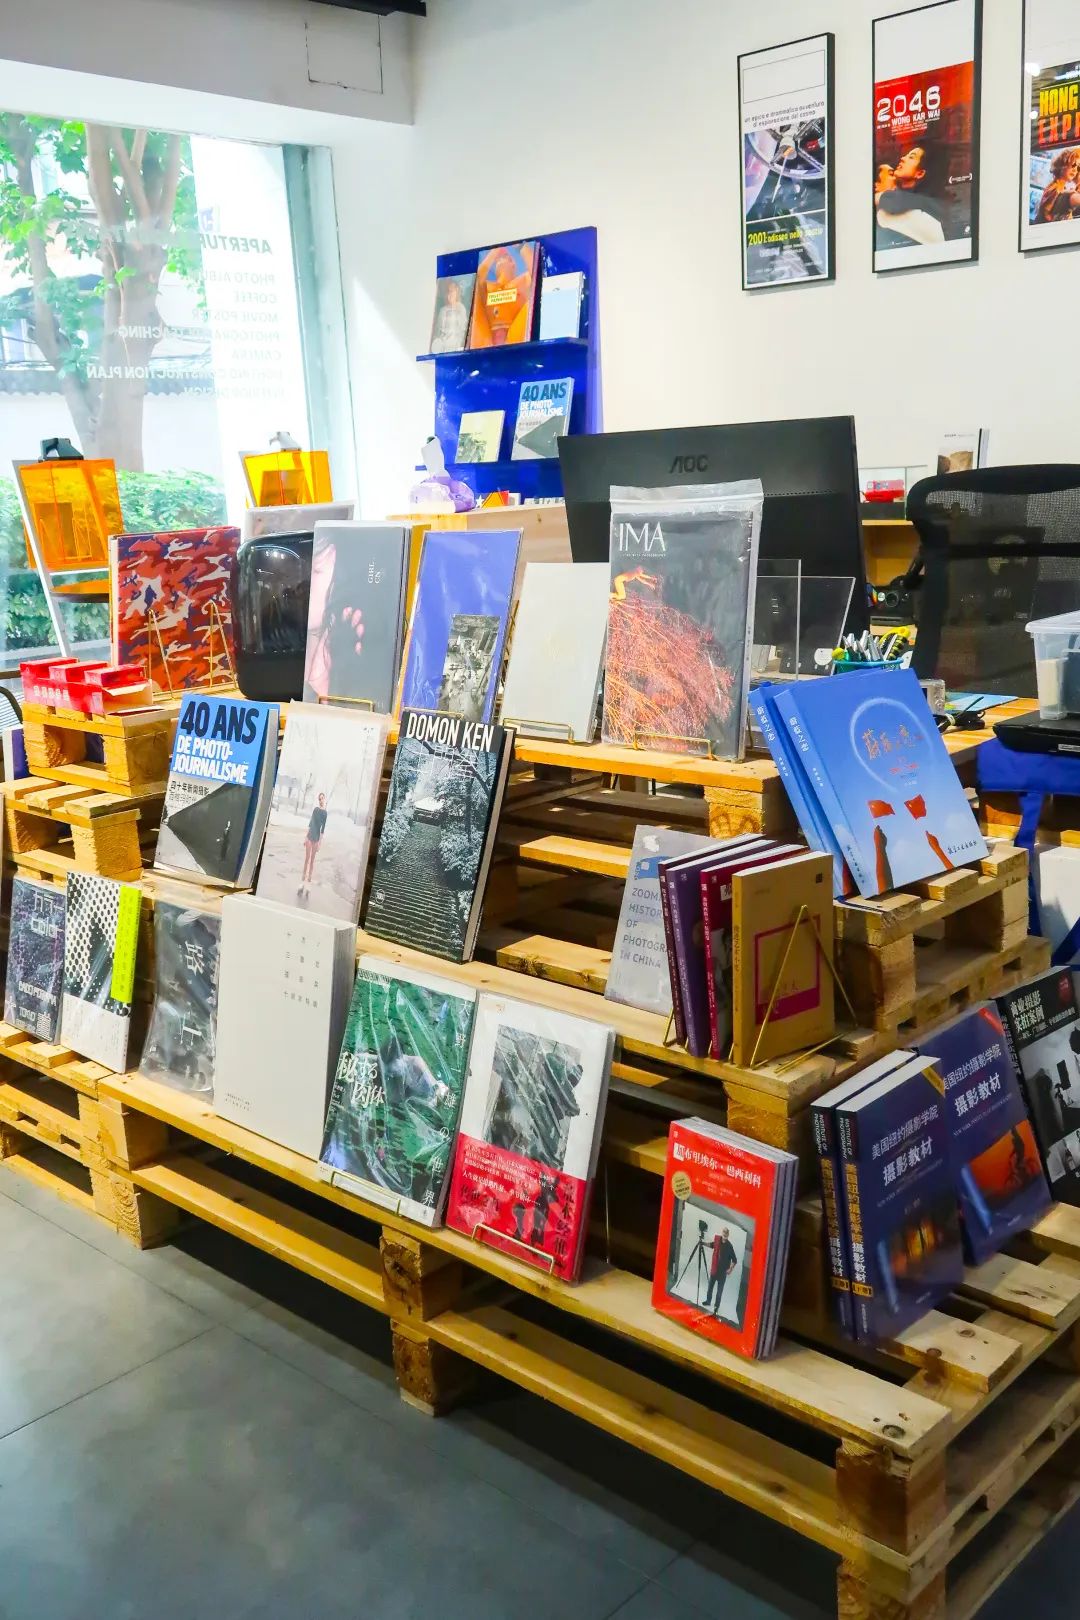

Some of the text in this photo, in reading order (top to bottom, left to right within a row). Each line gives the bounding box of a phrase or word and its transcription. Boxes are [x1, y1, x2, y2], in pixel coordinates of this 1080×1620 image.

[877, 86, 940, 122] 2046
[892, 115, 911, 126] WONG
[521, 382, 567, 401] 40 ANS
[669, 455, 709, 474] AOC
[619, 521, 667, 552] IMA
[180, 701, 260, 744] 40 ANS
[405, 712, 494, 752] DOMON KEN
[176, 734, 233, 761] DE PHOTO-
[172, 755, 249, 785] JOURNALISME
[626, 919, 638, 929] OF
[620, 949, 662, 968] IN CHINA
[954, 1072, 1002, 1117] 摄影教材
[872, 1104, 939, 1160] 美国纽约摄影学院
[882, 1136, 934, 1187] 摄影教材
